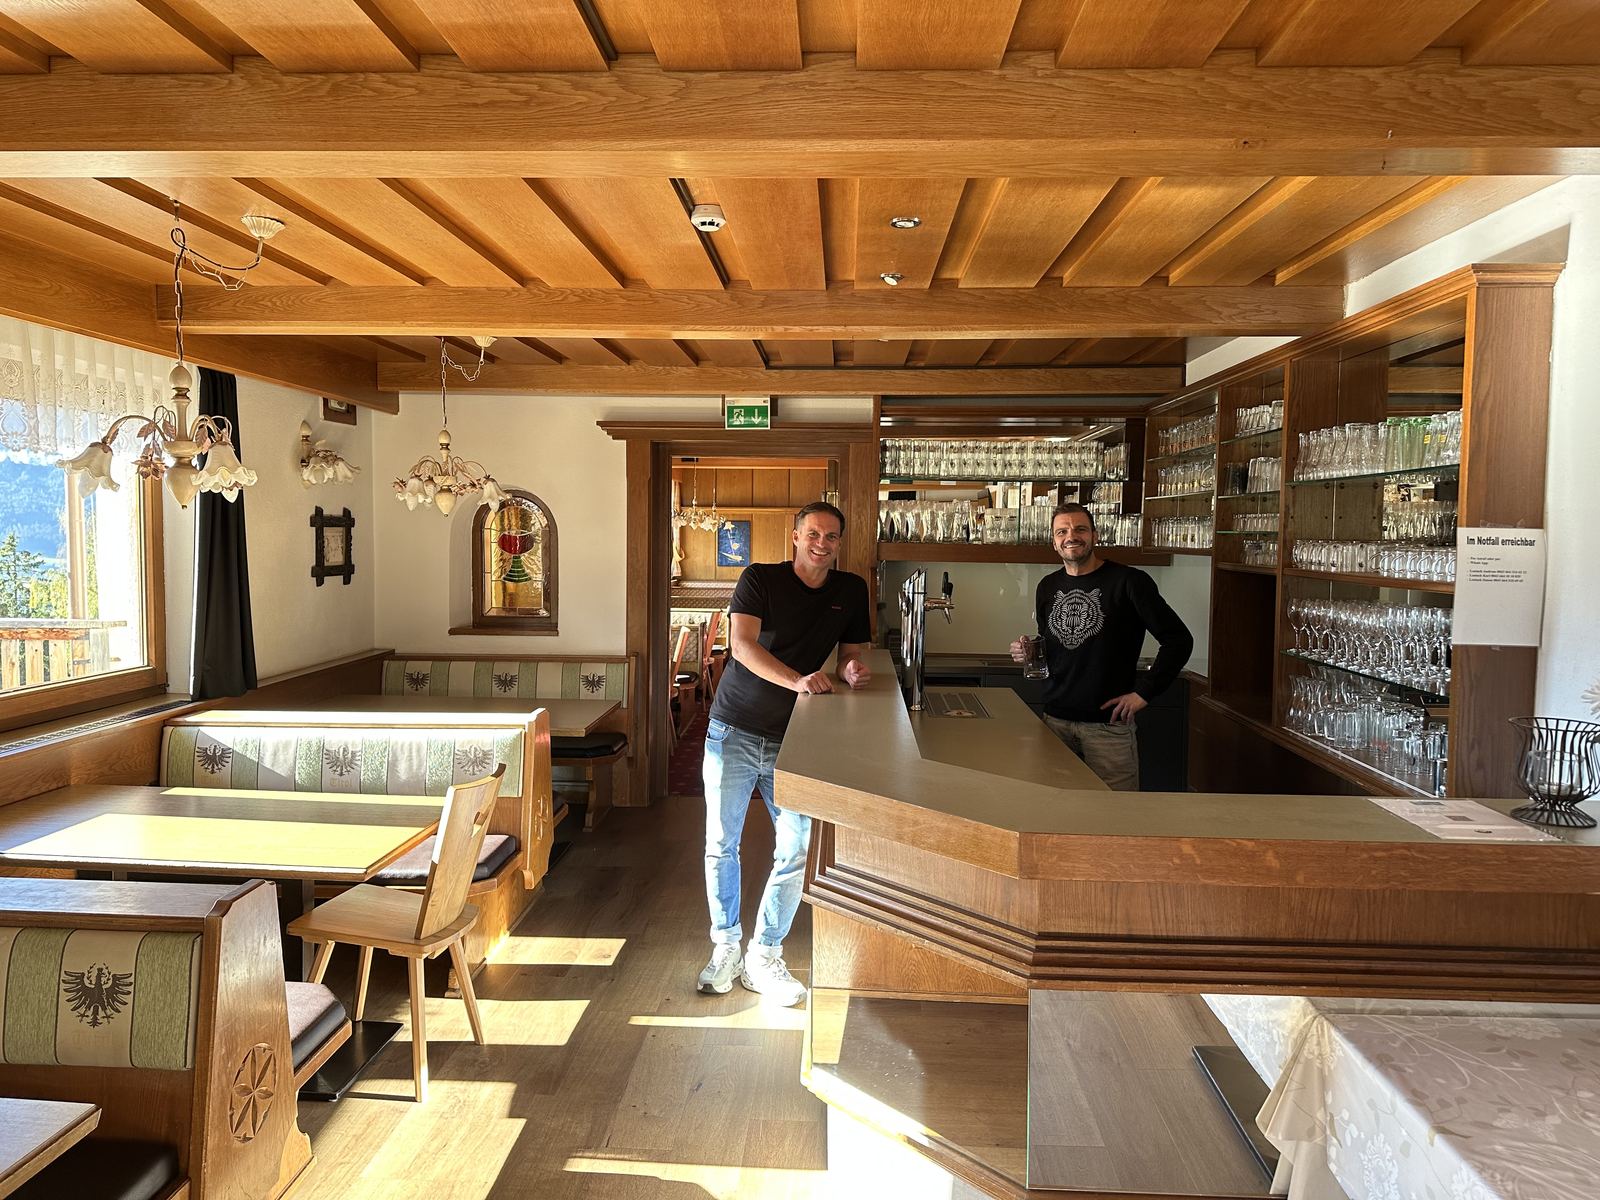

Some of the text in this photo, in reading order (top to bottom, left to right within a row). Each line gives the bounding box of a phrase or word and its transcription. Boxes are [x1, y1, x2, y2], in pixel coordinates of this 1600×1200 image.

[1466, 536, 1536, 547] Im Notfall erreichbar
